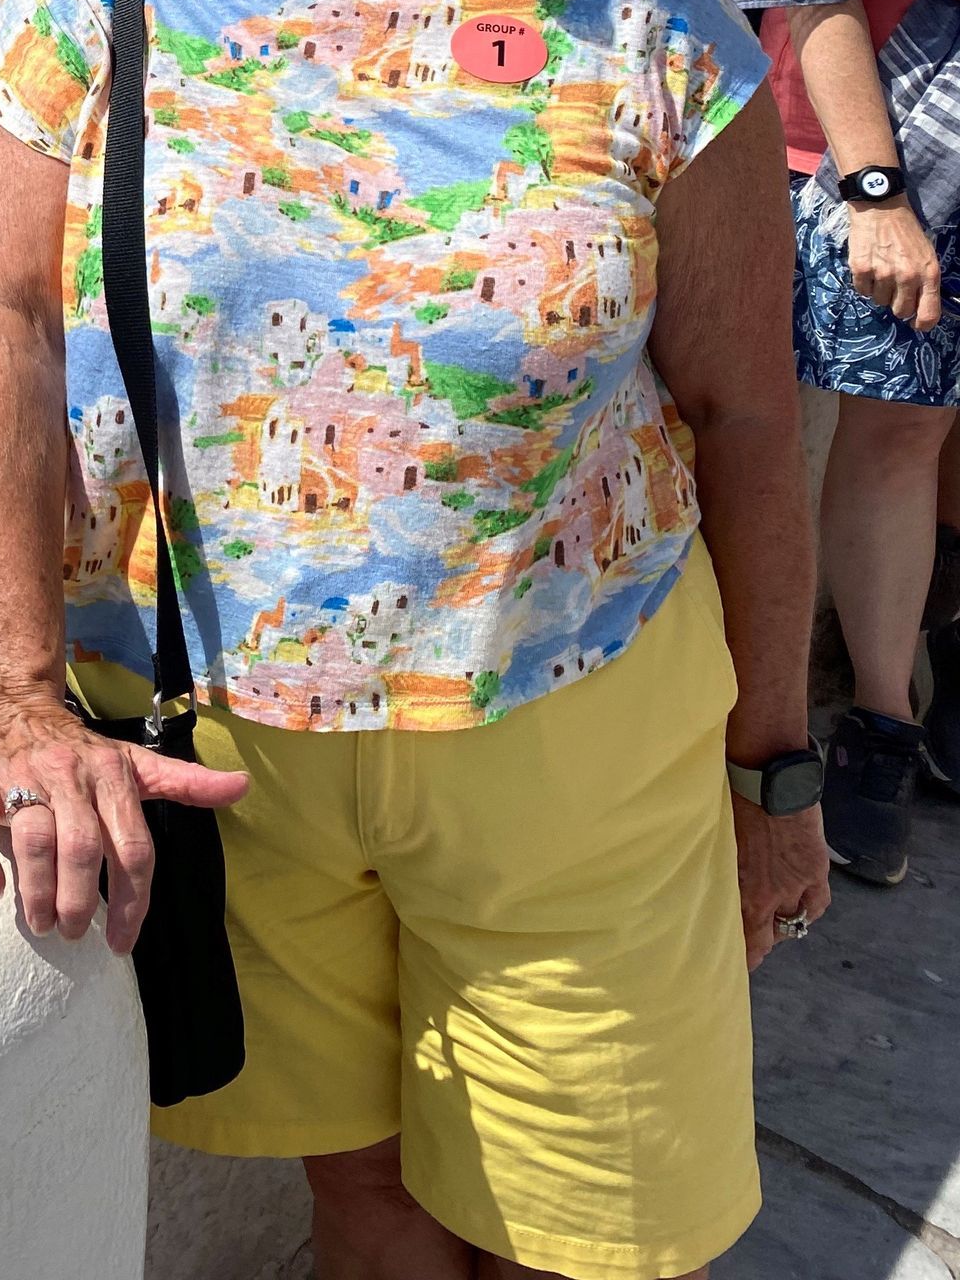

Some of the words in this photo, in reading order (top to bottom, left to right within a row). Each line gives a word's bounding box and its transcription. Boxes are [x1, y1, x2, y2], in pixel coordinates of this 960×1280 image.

[476, 22, 516, 35] GROUP
[518, 27, 525, 36] #
[492, 39, 505, 67] 1
